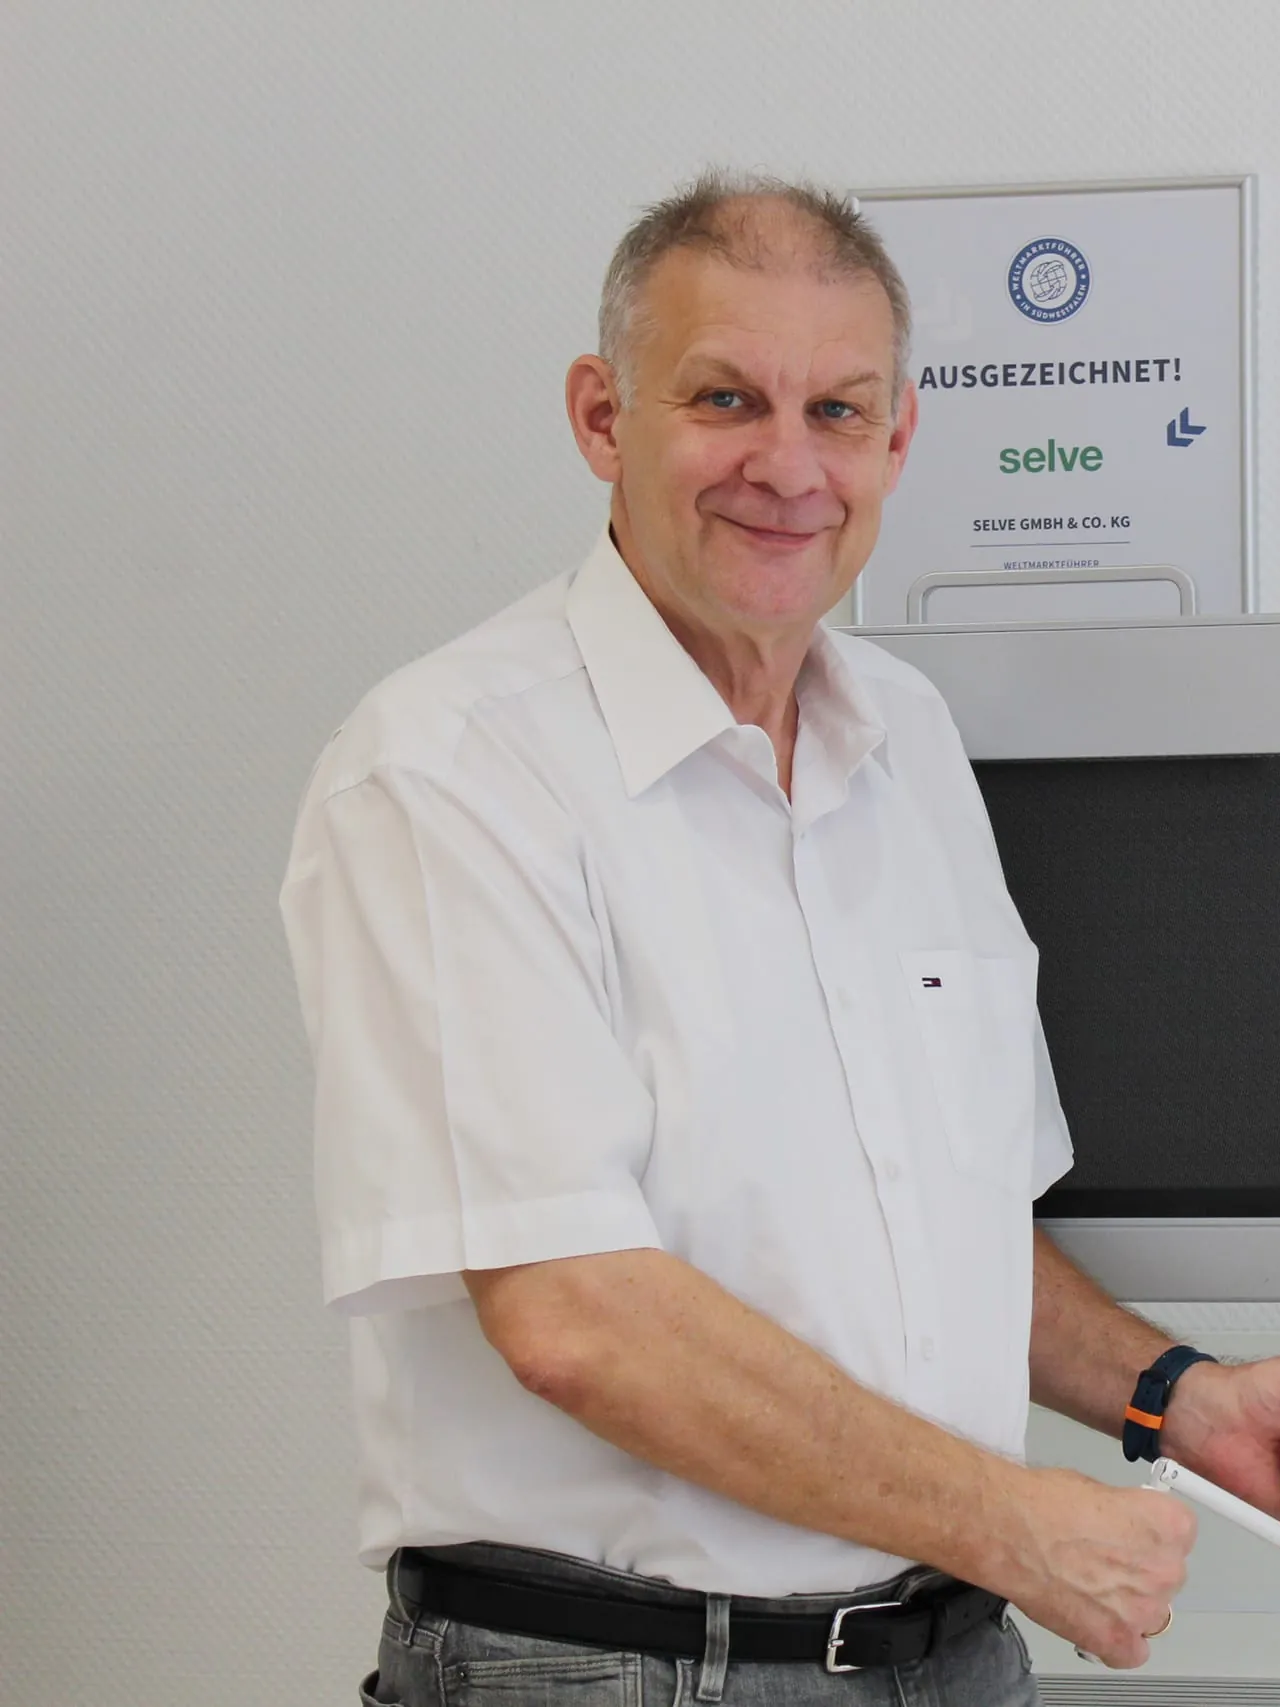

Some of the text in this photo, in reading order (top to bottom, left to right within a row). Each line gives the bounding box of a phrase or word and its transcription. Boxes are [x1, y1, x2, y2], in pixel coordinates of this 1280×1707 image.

[1012, 242, 1086, 291] WELTMARKTFÜHRER
[1020, 301, 1031, 311] IN
[919, 358, 1182, 389] AUSGEZEICHNET!
[999, 439, 1104, 474] selve
[973, 516, 1131, 532] SELVE GMBH & CO. KG
[1003, 560, 1100, 570] WELTMARKTFÜHRER
